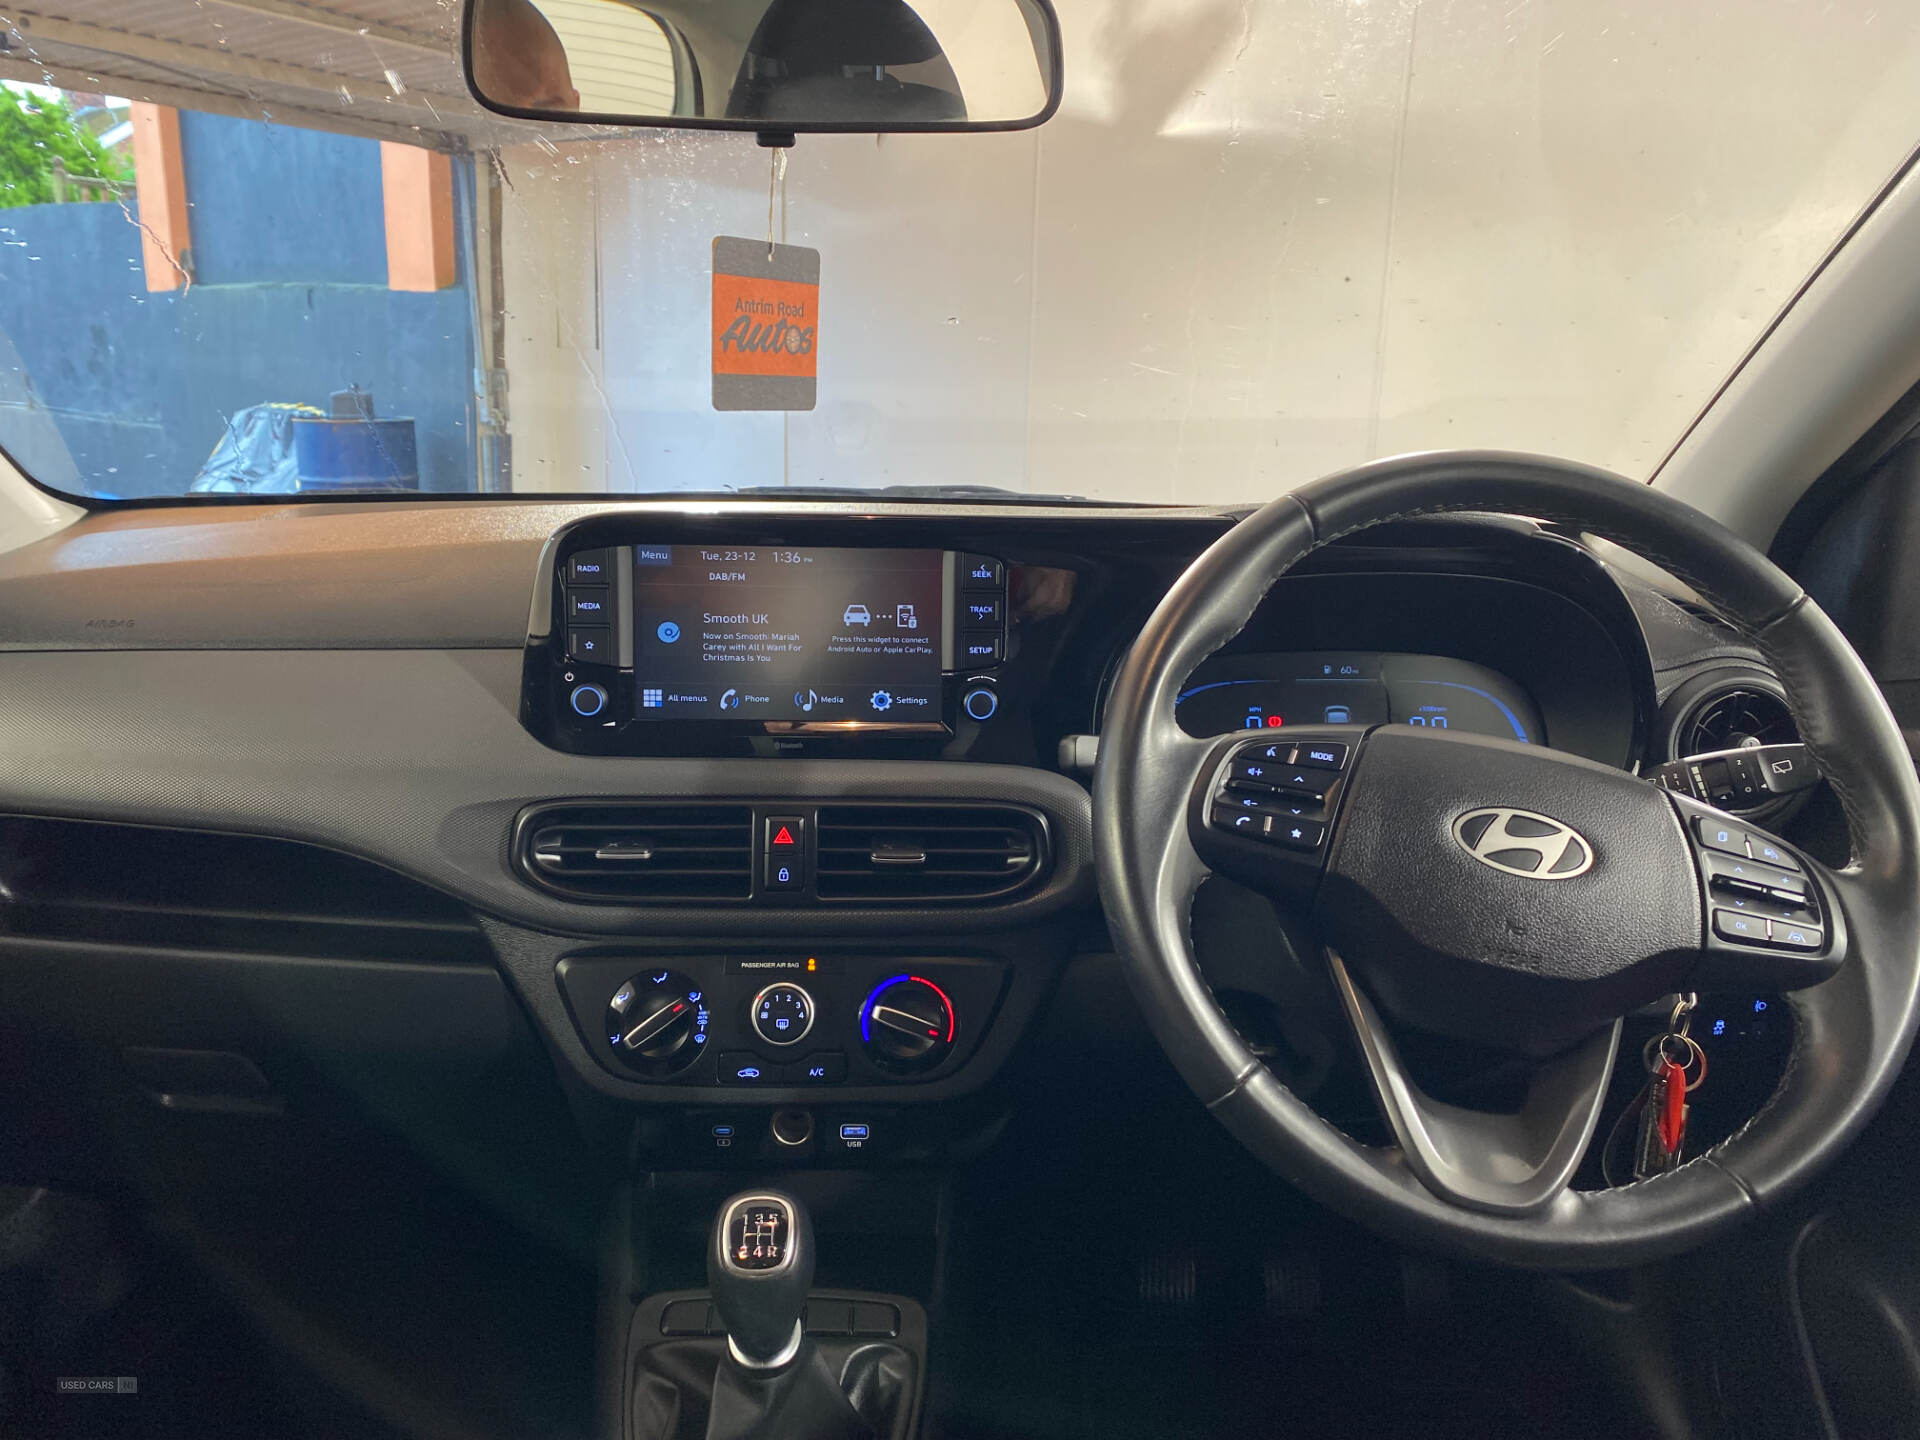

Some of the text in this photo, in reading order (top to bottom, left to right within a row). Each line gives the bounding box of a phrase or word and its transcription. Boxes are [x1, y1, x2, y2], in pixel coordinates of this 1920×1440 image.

[735, 296, 805, 317] Antrim Road
[719, 314, 815, 355] Autos
[641, 551, 668, 560] Menu
[725, 551, 756, 561] 23-12
[773, 552, 801, 563] 1:36
[709, 572, 746, 581] DAB/FM
[703, 613, 769, 624] Smooth UK
[703, 632, 721, 640] Now
[771, 633, 800, 641] Mariah
[868, 636, 891, 645] widget
[703, 643, 727, 652] Carey
[827, 645, 855, 653] Android
[883, 646, 903, 654] Apple
[703, 653, 746, 662] Christmas
[747, 654, 755, 662] Is
[1340, 665, 1352, 674] 60
[668, 694, 708, 703] All menus
[745, 694, 770, 703] Phone
[821, 695, 844, 704] Media
[896, 695, 928, 706] Settings
[1310, 751, 1334, 761] MODE
[1735, 921, 1747, 930] OK
[764, 1001, 770, 1009] 0
[809, 1068, 824, 1076] A/C
[742, 1213, 778, 1225] 1 3 5
[738, 1245, 778, 1259] 2 4 R
